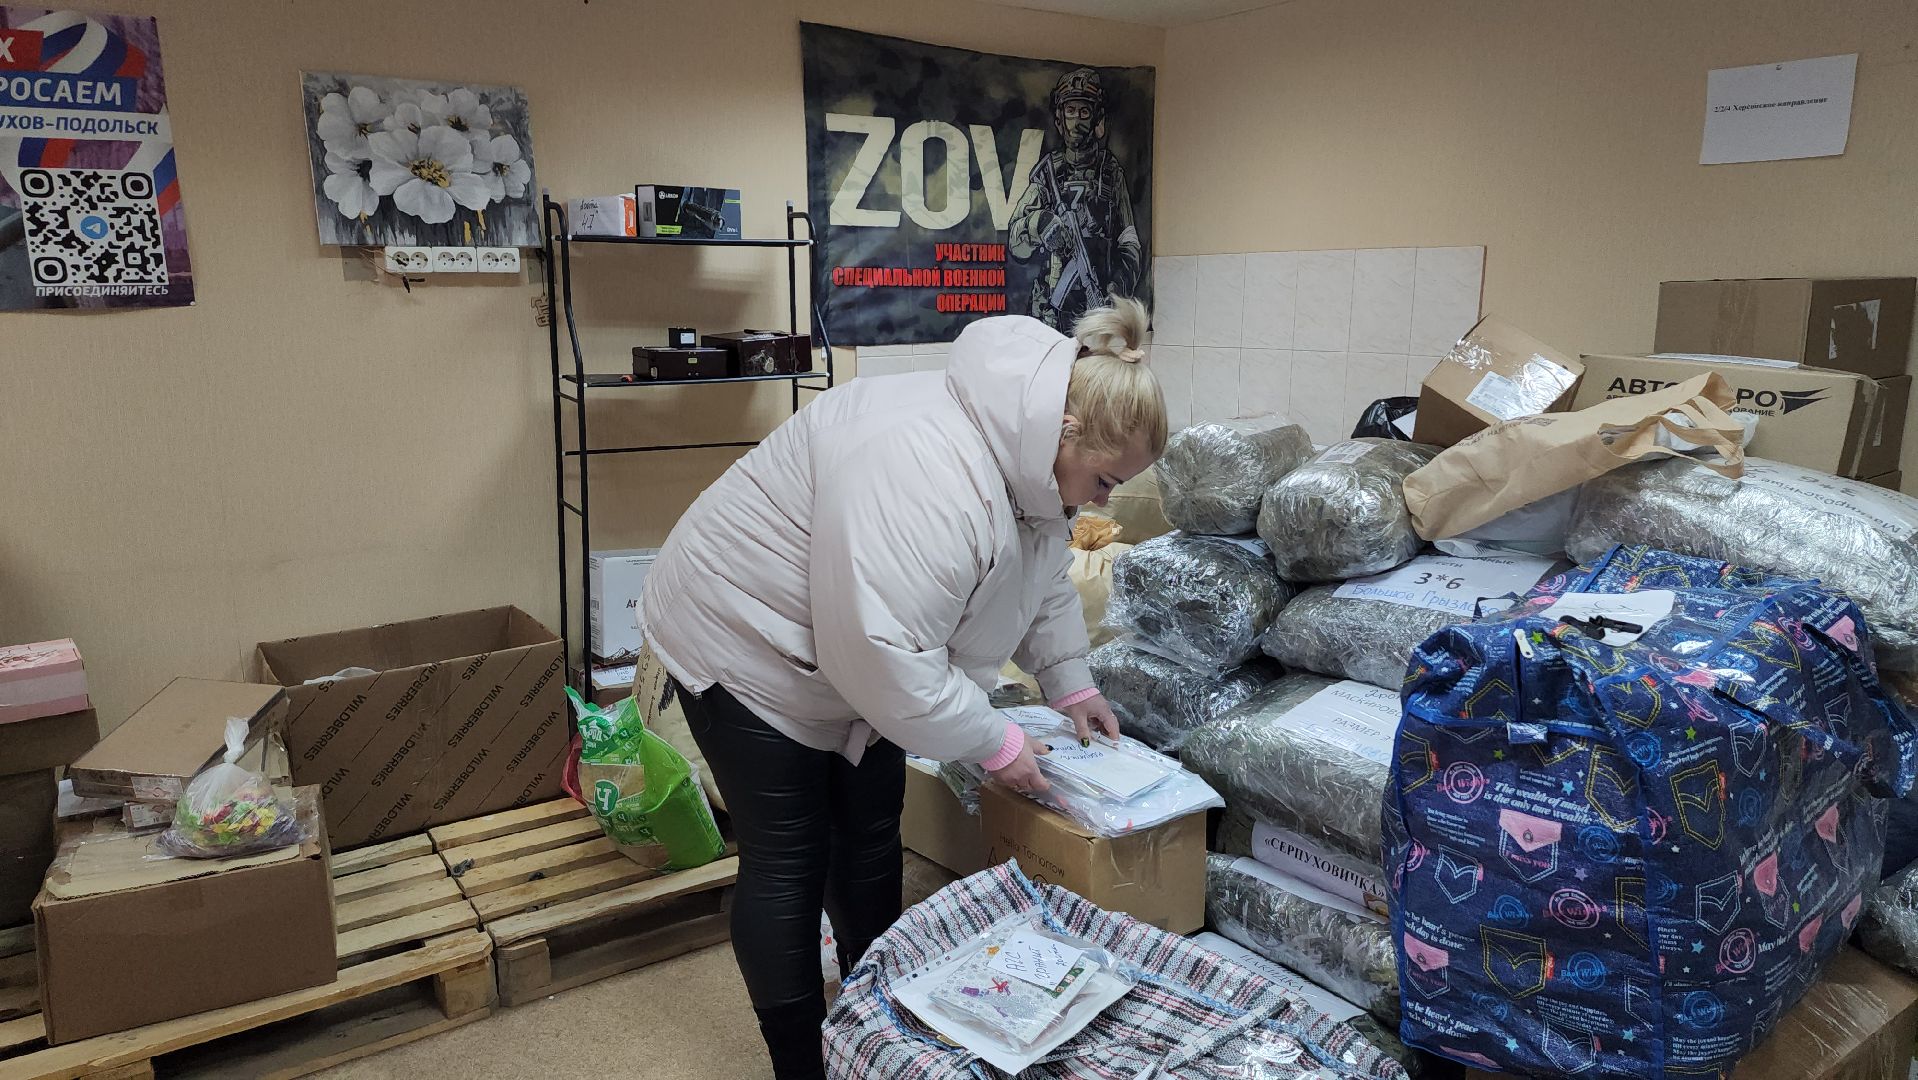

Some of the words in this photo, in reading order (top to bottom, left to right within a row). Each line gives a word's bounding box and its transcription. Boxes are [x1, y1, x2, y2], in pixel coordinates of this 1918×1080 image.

[825, 113, 1044, 231] ZOV
[832, 265, 941, 287] СПЕЦИАЛЬНОЙ
[944, 267, 1006, 288] ВОЕННОЙ
[935, 243, 1005, 262] УЧАСТНИК
[936, 293, 1006, 313] ОПЕРАЦИИ
[1352, 584, 1415, 602] Большое
[303, 694, 368, 762] WILDBERRIES
[447, 684, 505, 749] WILDBERRIES
[505, 709, 561, 774] WILDBERRIES
[371, 721, 431, 788] WILDBERRIES
[433, 747, 490, 812] WILDBERRIES
[999, 834, 1020, 852] Hello
[1022, 845, 1065, 878] Tomorrow
[1264, 837, 1385, 898] «СЕРПУХОВИЧКА»
[1425, 1006, 1454, 1025] heart's
